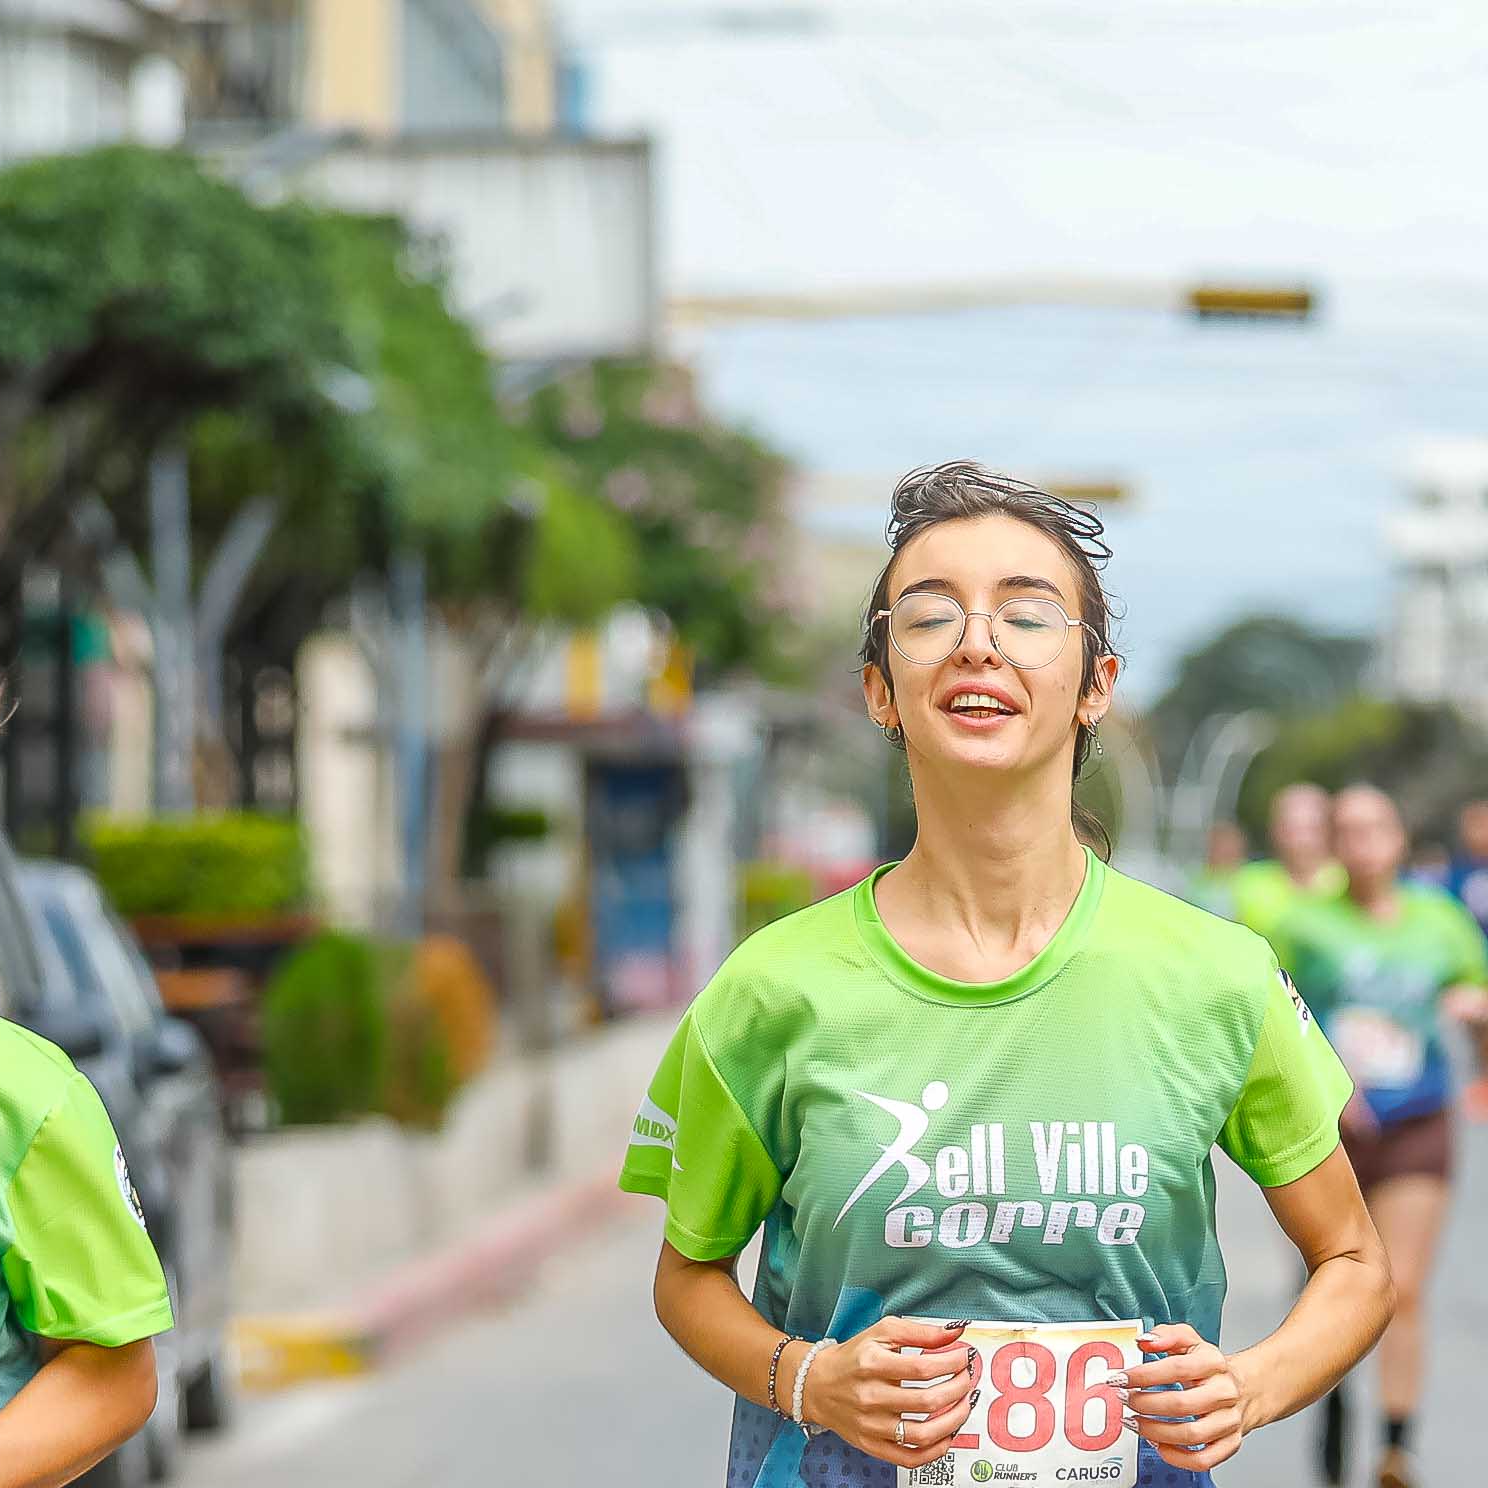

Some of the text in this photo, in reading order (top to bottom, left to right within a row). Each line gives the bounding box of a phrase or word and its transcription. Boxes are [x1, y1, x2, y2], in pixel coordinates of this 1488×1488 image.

[1028, 1121, 1149, 1198] Ville
[884, 1200, 1147, 1249] corre
[995, 1463, 1019, 1472] CLUB
[1055, 1465, 1121, 1481] CARUSO
[993, 1471, 1038, 1482] RUNNER'S
